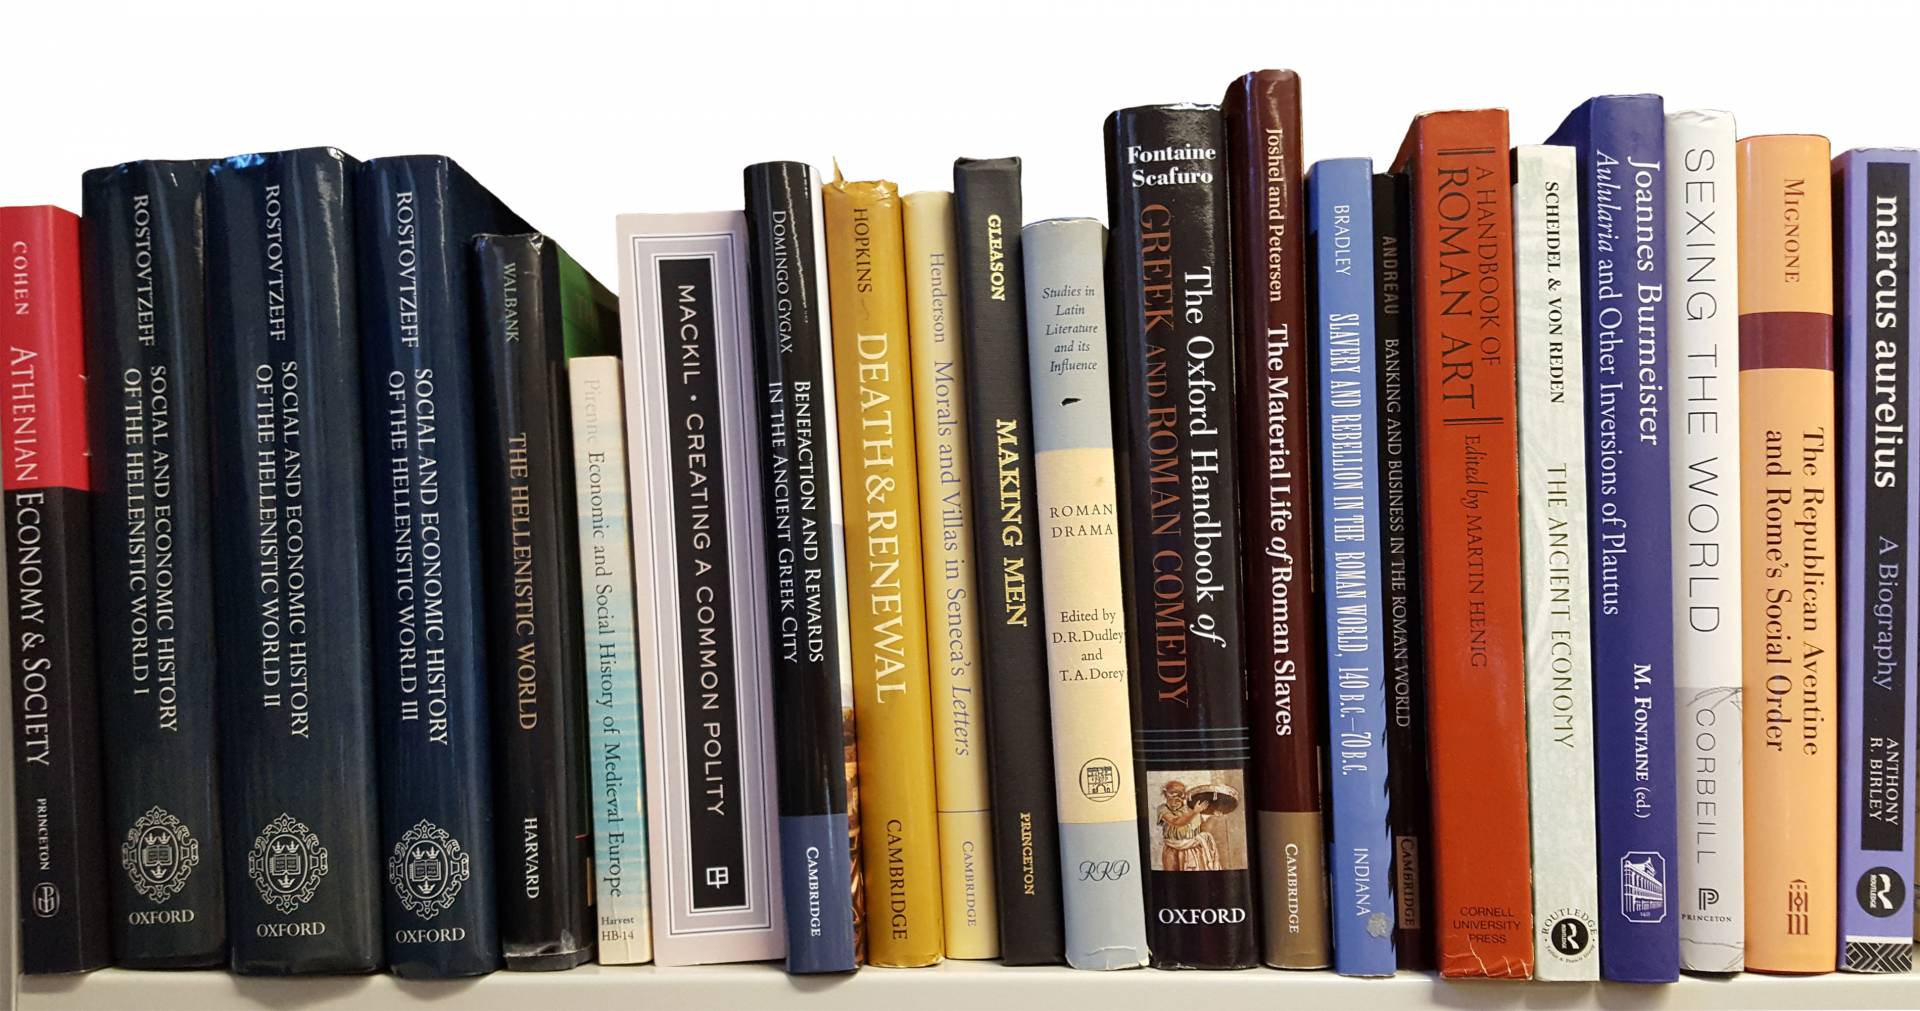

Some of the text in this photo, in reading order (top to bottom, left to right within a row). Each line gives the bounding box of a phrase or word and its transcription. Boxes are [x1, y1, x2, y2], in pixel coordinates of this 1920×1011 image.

[1127, 143, 1217, 165] Fontaine
[1132, 166, 1214, 188] Scafuro
[264, 184, 286, 342] ROSTOVTZEFF
[853, 208, 873, 293] HOPKINS
[986, 213, 1006, 301] GLEASON
[1265, 128, 1286, 302] Joshel Petersen
[1333, 204, 1352, 276] BRADLEY
[1475, 188, 1500, 328] HANDBOOK
[1782, 177, 1805, 284] MIGNONE
[12, 240, 31, 317] COHEN
[132, 194, 155, 346] ROSTOVTZEFF
[395, 191, 419, 349] ROSTOVTZEFF
[502, 262, 520, 343] WALBANK
[771, 209, 793, 354] DOMINGO GYGAX
[928, 252, 947, 344] Henderson
[1042, 285, 1081, 299] Studies
[1056, 304, 1085, 316] Latin
[1381, 235, 1400, 315] ANDREAU
[1435, 166, 1476, 411] ROMAN ART
[1544, 181, 1565, 405] SCHEIDEL REDEN
[1627, 156, 1663, 447] Joannes Burmeister
[1046, 324, 1098, 336] Literature
[1050, 359, 1098, 376] Influence
[1328, 313, 1361, 374] SLAVERY
[1874, 195, 1904, 488] marcus aurelius
[1595, 149, 1627, 616] Aulularia and Other Inversions Plautus
[1684, 148, 1721, 634] SEXING THE WORLD
[1140, 203, 1189, 709] GREEK AND ROMAN COMEDY
[1183, 265, 1224, 603] The Oxford Handbook
[1329, 414, 1364, 490] REBELLION
[11, 345, 52, 766] ATHENIAN ECONOMY SOCIETY
[148, 364, 178, 732] SOCIAL AND ECONOMIC HISTORY
[280, 360, 309, 740] SOCIAL AND ECONOMIC HISTORY
[414, 368, 448, 746] SOCIAL AND ECONOMIC HISTORY
[677, 284, 726, 816] MACKIL CREATING COMMON POLITY
[771, 454, 799, 664] ANCIENT GREEK CITY
[792, 380, 824, 663] BENEFACTION REWARDS
[933, 360, 972, 757] Morals and Villas Seneca's Letters
[995, 418, 1027, 628] MAKING MEN
[1049, 504, 1113, 518] ROMAN
[1051, 524, 1113, 538] DRAMA
[1266, 323, 1296, 737] The Material Life Roman Slaves
[1332, 515, 1366, 542] THE
[1384, 338, 1410, 728] BANKING BUSINESS ROMAN WORLD
[1462, 434, 1488, 668] Edited MARTIN HENIG
[126, 451, 150, 681] HELLENISTIC WORLD
[257, 450, 282, 686] HELLENISTIC WORLD
[391, 457, 418, 693] HELLENISTIC WORLD
[508, 432, 538, 730] THE HELLENISTIC WORLD
[1333, 551, 1367, 598] ROMAN
[1546, 462, 1574, 748] THE ANCIENT ECONOMY
[1764, 430, 1793, 753] and Rome's Social Order
[1794, 426, 1826, 756] The Republican Aventine
[1060, 609, 1098, 623] Edited
[1334, 604, 1369, 658] WORLD,
[1872, 562, 1900, 691] Biography
[588, 451, 626, 897] Economic Social History Medieval Europe
[1632, 696, 1653, 819] FONTAINE (ed.)
[1695, 708, 1717, 864] CORBEILL
[1869, 758, 1884, 821] BIRLEY
[1885, 736, 1900, 826] ANTHONY
[36, 797, 51, 871] PRINCETON
[522, 817, 541, 899] HARVARD
[885, 819, 908, 940] CAMBRIDGE
[961, 840, 978, 927] CAMBRIDGE
[1019, 812, 1036, 896] PRINCETON
[1352, 847, 1371, 917] INDIANA
[1401, 838, 1417, 928] CAMBRIDGE
[128, 911, 195, 926] OXFORD
[257, 923, 326, 939] OXFORD
[395, 929, 465, 944] OXFORD
[805, 845, 822, 937] CAMBRIDGE
[1157, 908, 1246, 925] OXFORD
[1284, 843, 1300, 934] CAMBRIDGE
[1453, 919, 1521, 930] UNIVERSITY
[1460, 906, 1515, 917] CORNELL
[1541, 907, 1598, 936] ROUTLEDGE
[1468, 933, 1507, 944] PRESS
